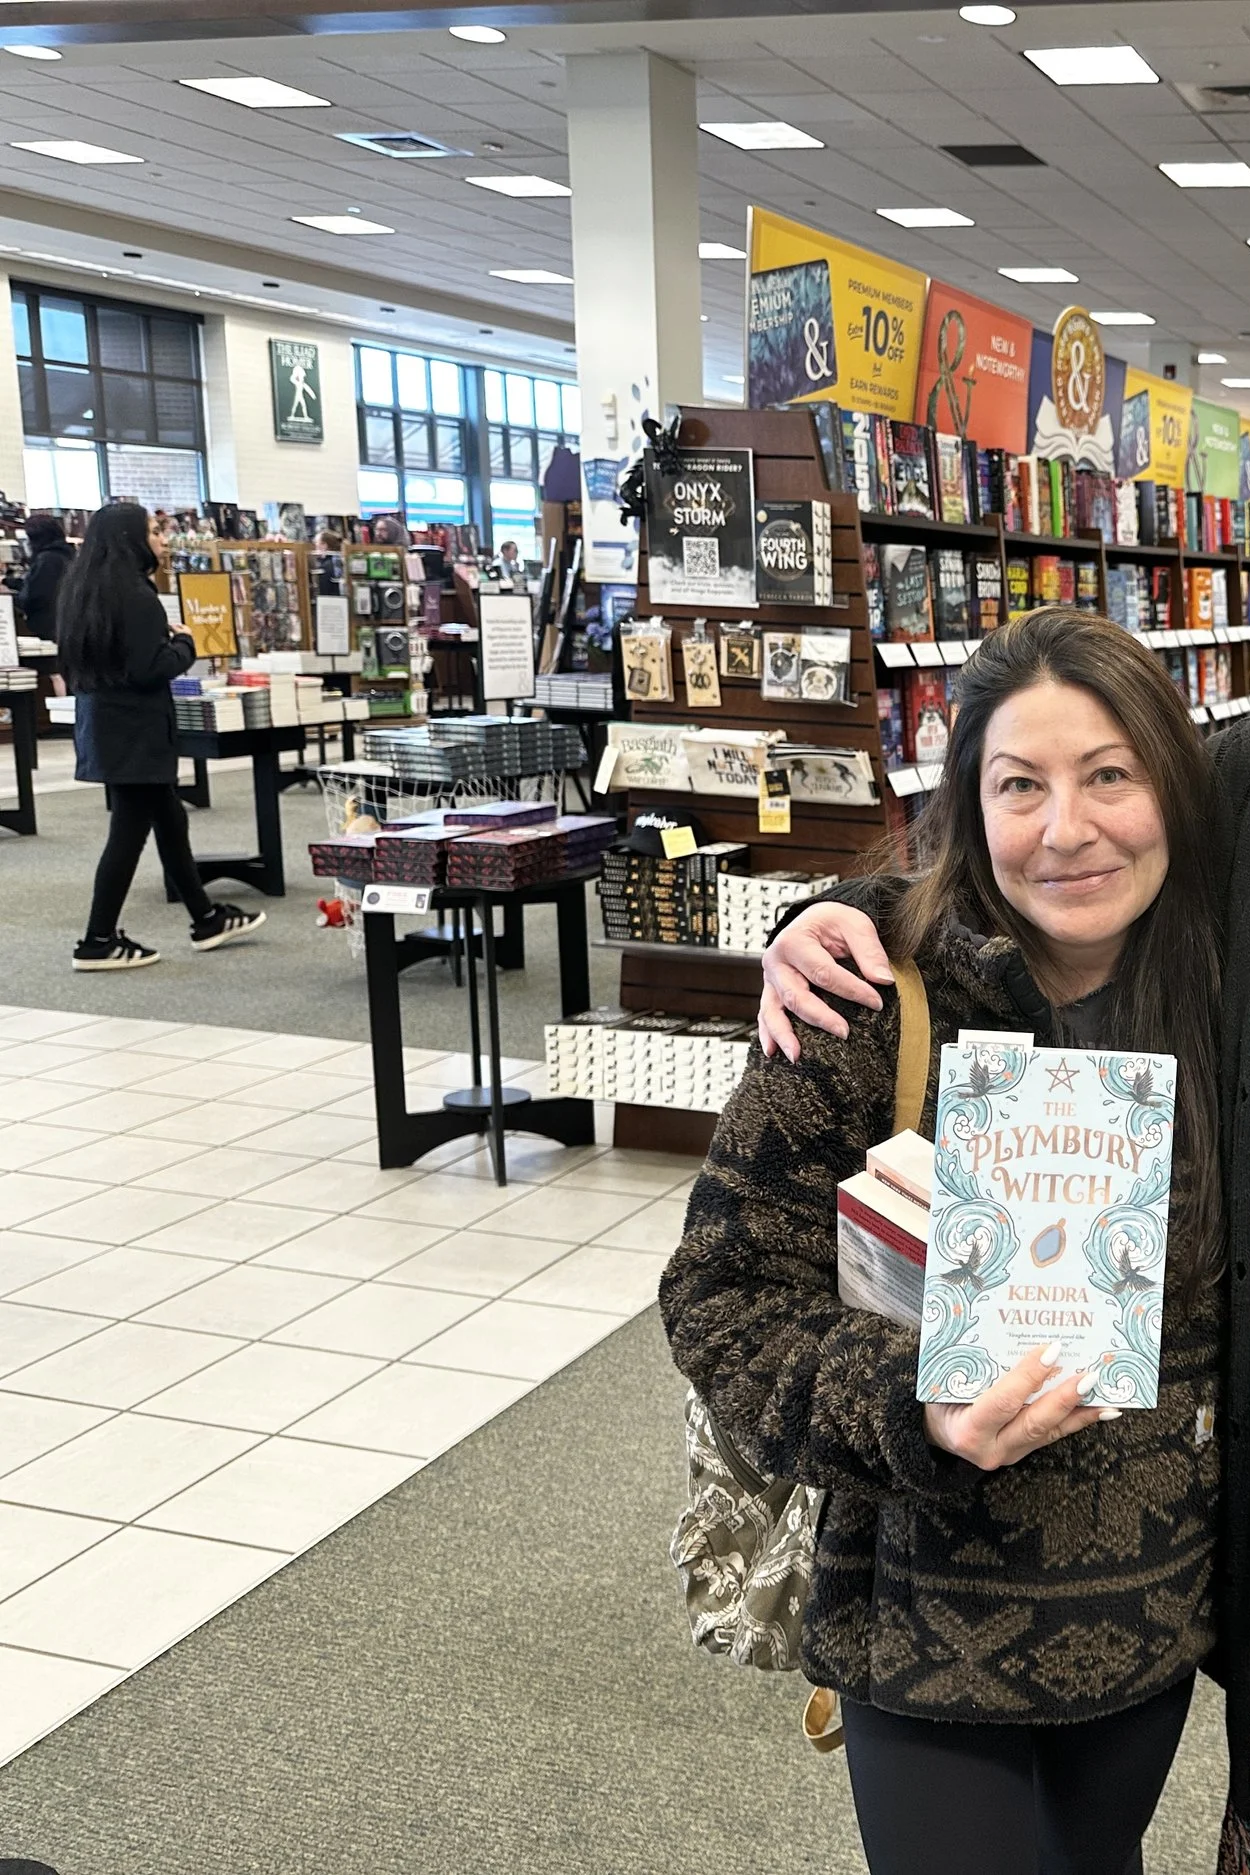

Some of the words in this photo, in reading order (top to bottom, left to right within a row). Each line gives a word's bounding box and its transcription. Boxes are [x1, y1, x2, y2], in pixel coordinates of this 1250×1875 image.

[752, 291, 792, 315] EMIUM
[848, 279, 881, 300] PREMIUM
[882, 292, 914, 313] MEMBERS
[750, 312, 794, 333] MBERSHIP
[862, 305, 904, 357] 10%
[887, 345, 905, 363] OFF
[991, 335, 1009, 355] NEW
[975, 353, 1025, 384] NOTEWORTHY
[850, 378, 868, 392] EARN
[869, 383, 899, 402] REWARDS
[685, 464, 714, 472] RAGON
[674, 482, 722, 502] ONYX
[674, 507, 726, 526] STORM
[760, 537, 806, 552] FOURTH
[761, 551, 808, 571] WING
[713, 748, 718, 758] I
[722, 749, 749, 761] WILL
[716, 772, 758, 785] TODAY
[1043, 1101, 1077, 1117] THE
[966, 1124, 1149, 1174] PLYMBURY
[991, 1166, 1112, 1205] WITCH
[1008, 1284, 1089, 1303] KENDRA
[998, 1308, 1095, 1327] VAUGHAN
